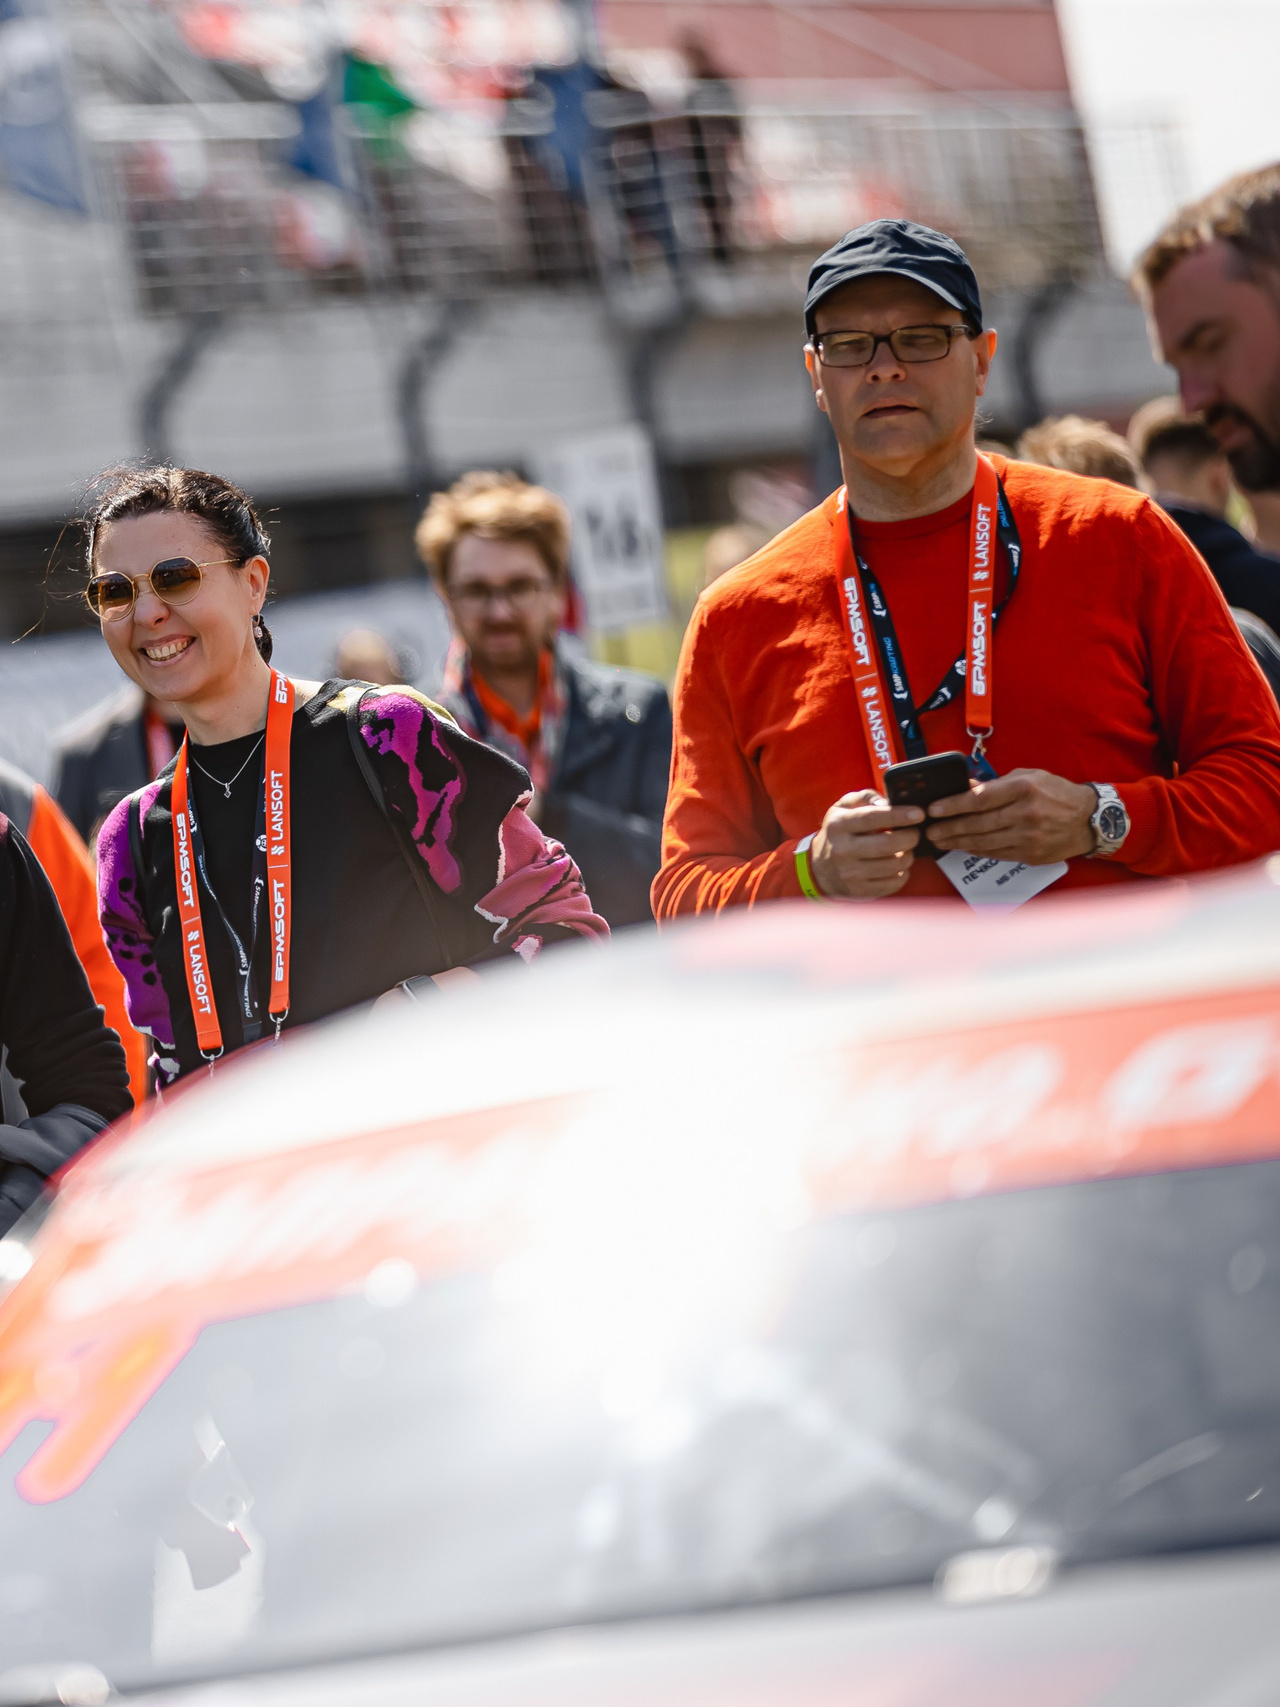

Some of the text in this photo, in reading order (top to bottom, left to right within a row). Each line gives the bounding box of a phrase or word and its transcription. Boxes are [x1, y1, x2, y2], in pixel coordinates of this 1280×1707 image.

[973, 503, 991, 568] LANSOFT
[844, 576, 870, 666] BPMSOFT
[971, 601, 988, 697] BPMSOFT
[862, 701, 892, 769] LANSOFT
[271, 770, 284, 841] LANSOFT
[176, 812, 195, 908] BPMSOFT
[273, 880, 285, 982] BPMSOFT
[187, 943, 212, 1015] LANSOFT
